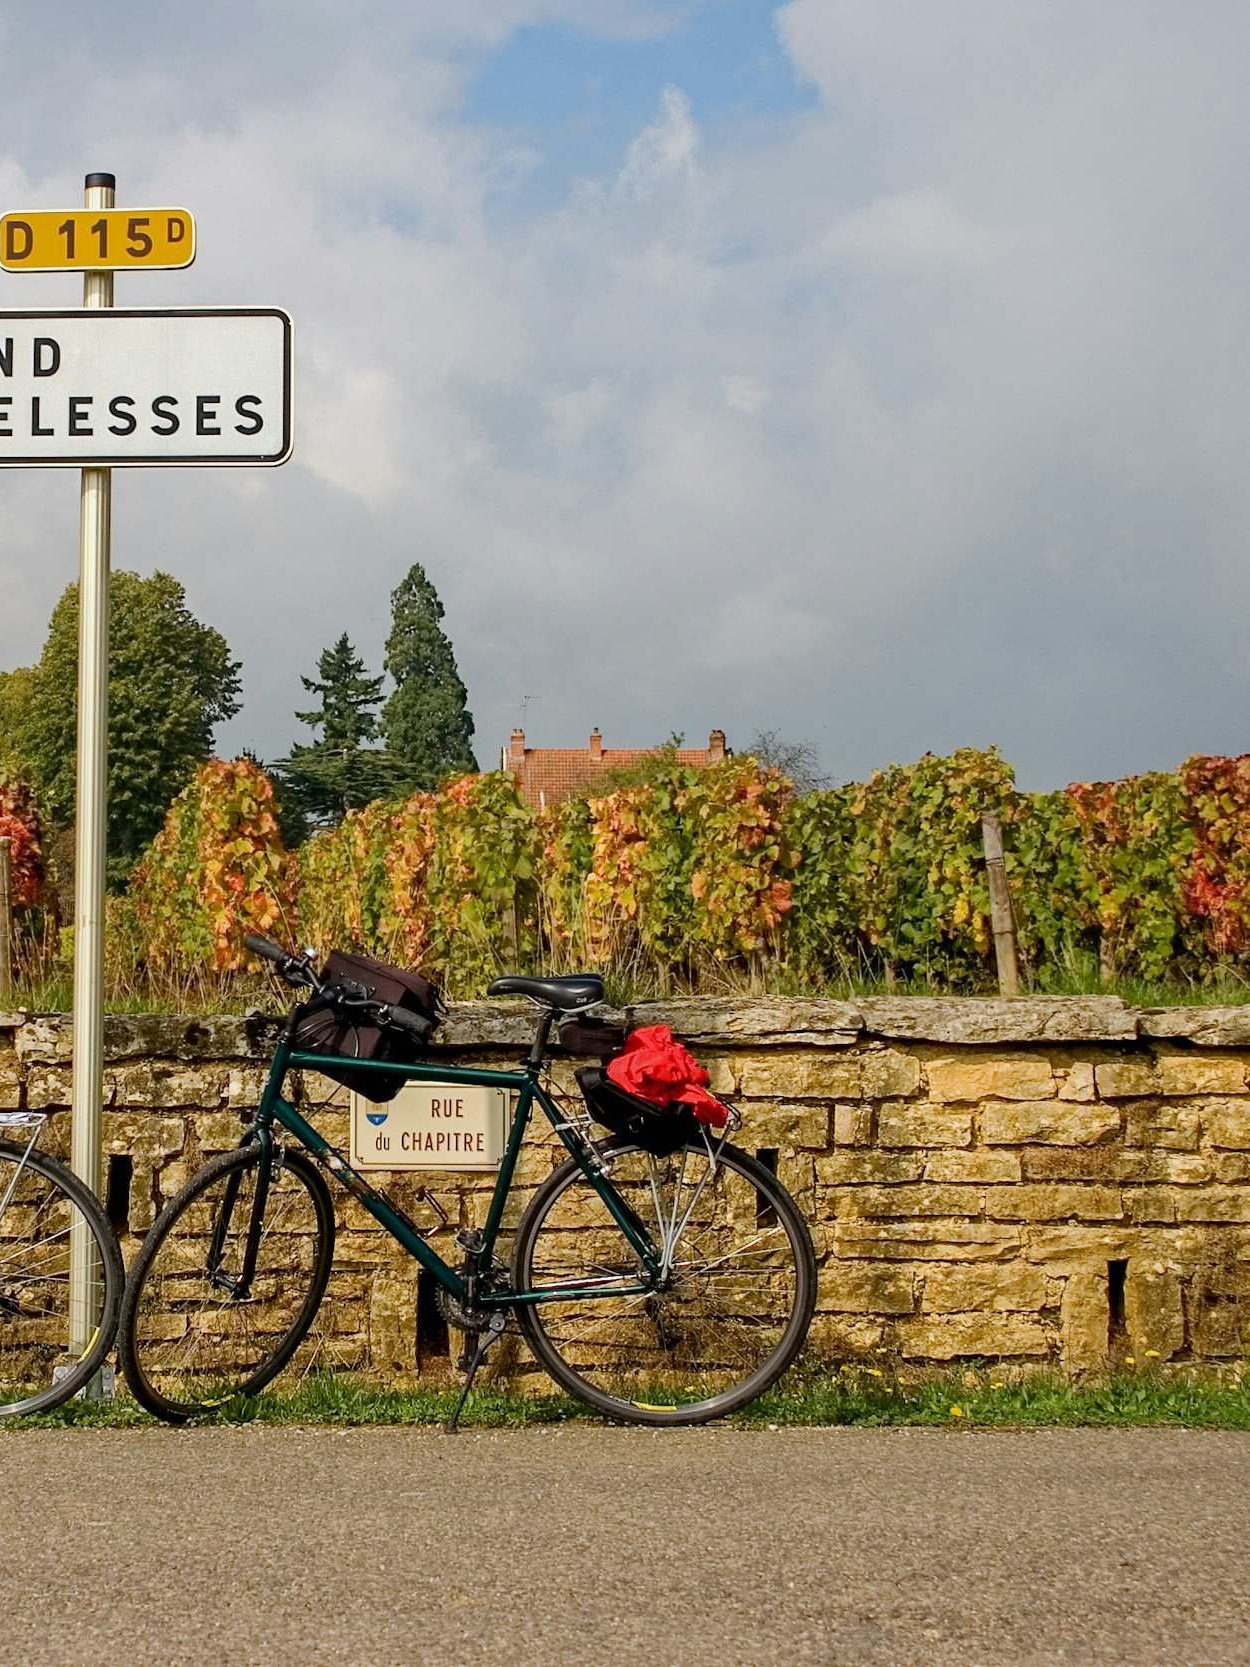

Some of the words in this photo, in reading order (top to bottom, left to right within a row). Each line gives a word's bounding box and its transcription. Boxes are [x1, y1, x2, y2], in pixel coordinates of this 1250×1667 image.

[5, 220, 34, 261] D
[431, 1099, 464, 1118] RUE
[375, 1131, 391, 1151] du
[401, 1131, 485, 1152] CHAPITRE
